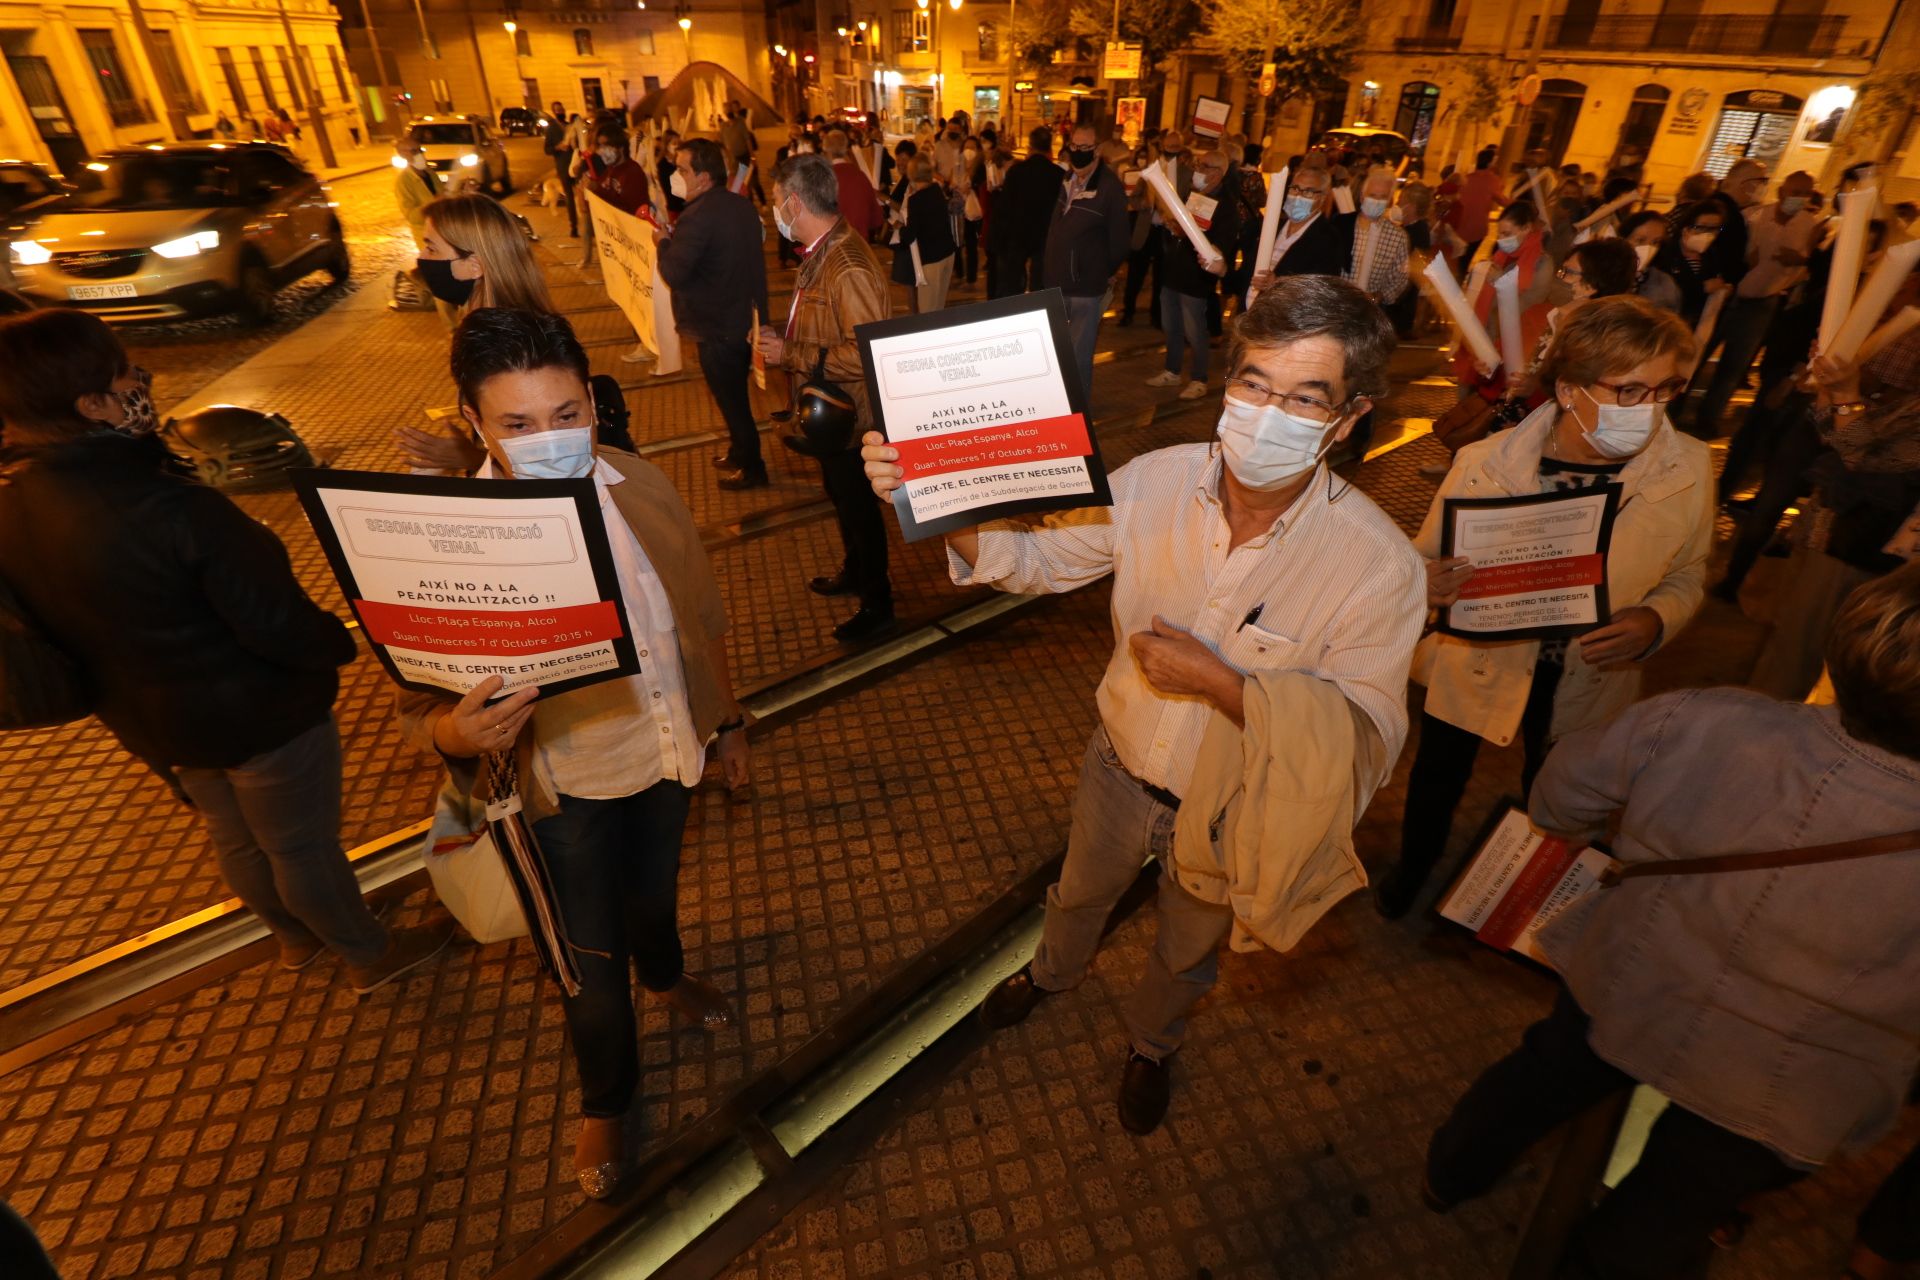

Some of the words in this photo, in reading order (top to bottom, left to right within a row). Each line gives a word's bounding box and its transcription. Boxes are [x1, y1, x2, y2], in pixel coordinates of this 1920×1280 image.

[76, 287, 104, 298] 9657
[109, 285, 133, 296] KPP
[937, 339, 1024, 368] CONCENTRACIÓ
[932, 406, 955, 418] AIXÍ
[959, 405, 976, 414] NO
[992, 400, 1007, 408] LA
[916, 408, 1023, 432] PEATONALITZACIÓ
[948, 436, 972, 448] Plaça
[973, 430, 1014, 444] Espanya,
[1016, 428, 1038, 438] Alcoi
[939, 454, 979, 467] Dimecres
[980, 452, 985, 460] 7
[1037, 443, 1058, 453] 20:15
[910, 480, 958, 499] UNEIX-TE,
[958, 479, 972, 488] EL
[973, 472, 1011, 485] CENTRE
[1014, 471, 1026, 479] ET
[1028, 465, 1084, 478] NECESSITA
[913, 503, 938, 515] Tenim
[940, 495, 968, 509] permis
[970, 492, 980, 501] de
[981, 489, 989, 498] la
[991, 483, 1045, 498] Subdelegació
[1047, 482, 1058, 490] de
[1059, 480, 1090, 489] Govern
[425, 523, 543, 540] CONCENTRACIÓ
[419, 579, 448, 591] AIXÍ
[454, 582, 476, 592] NO
[481, 583, 493, 592] A
[499, 583, 517, 592] LA
[398, 590, 539, 605] PEATONALITZACIÓ
[546, 594, 556, 603] !!
[1505, 599, 1537, 608] CENTRO
[1550, 593, 1589, 603] NECESITA
[438, 616, 470, 628] Plaça
[472, 617, 524, 630] Espanya,
[527, 616, 557, 627] Alcoi
[425, 635, 476, 648] Dimecres
[479, 638, 486, 647] 7
[488, 638, 498, 648] d'
[554, 630, 582, 643] 20:15
[585, 629, 592, 638] h
[394, 653, 446, 672] UNEIX-TE,
[450, 662, 463, 673] EL
[466, 664, 516, 675] CENTRE
[520, 662, 536, 673] ET
[539, 648, 610, 670] NECESSITA
[461, 679, 473, 690] de
[498, 672, 561, 691] bdelegació
[563, 669, 576, 679] de
[579, 659, 616, 674] Govern
